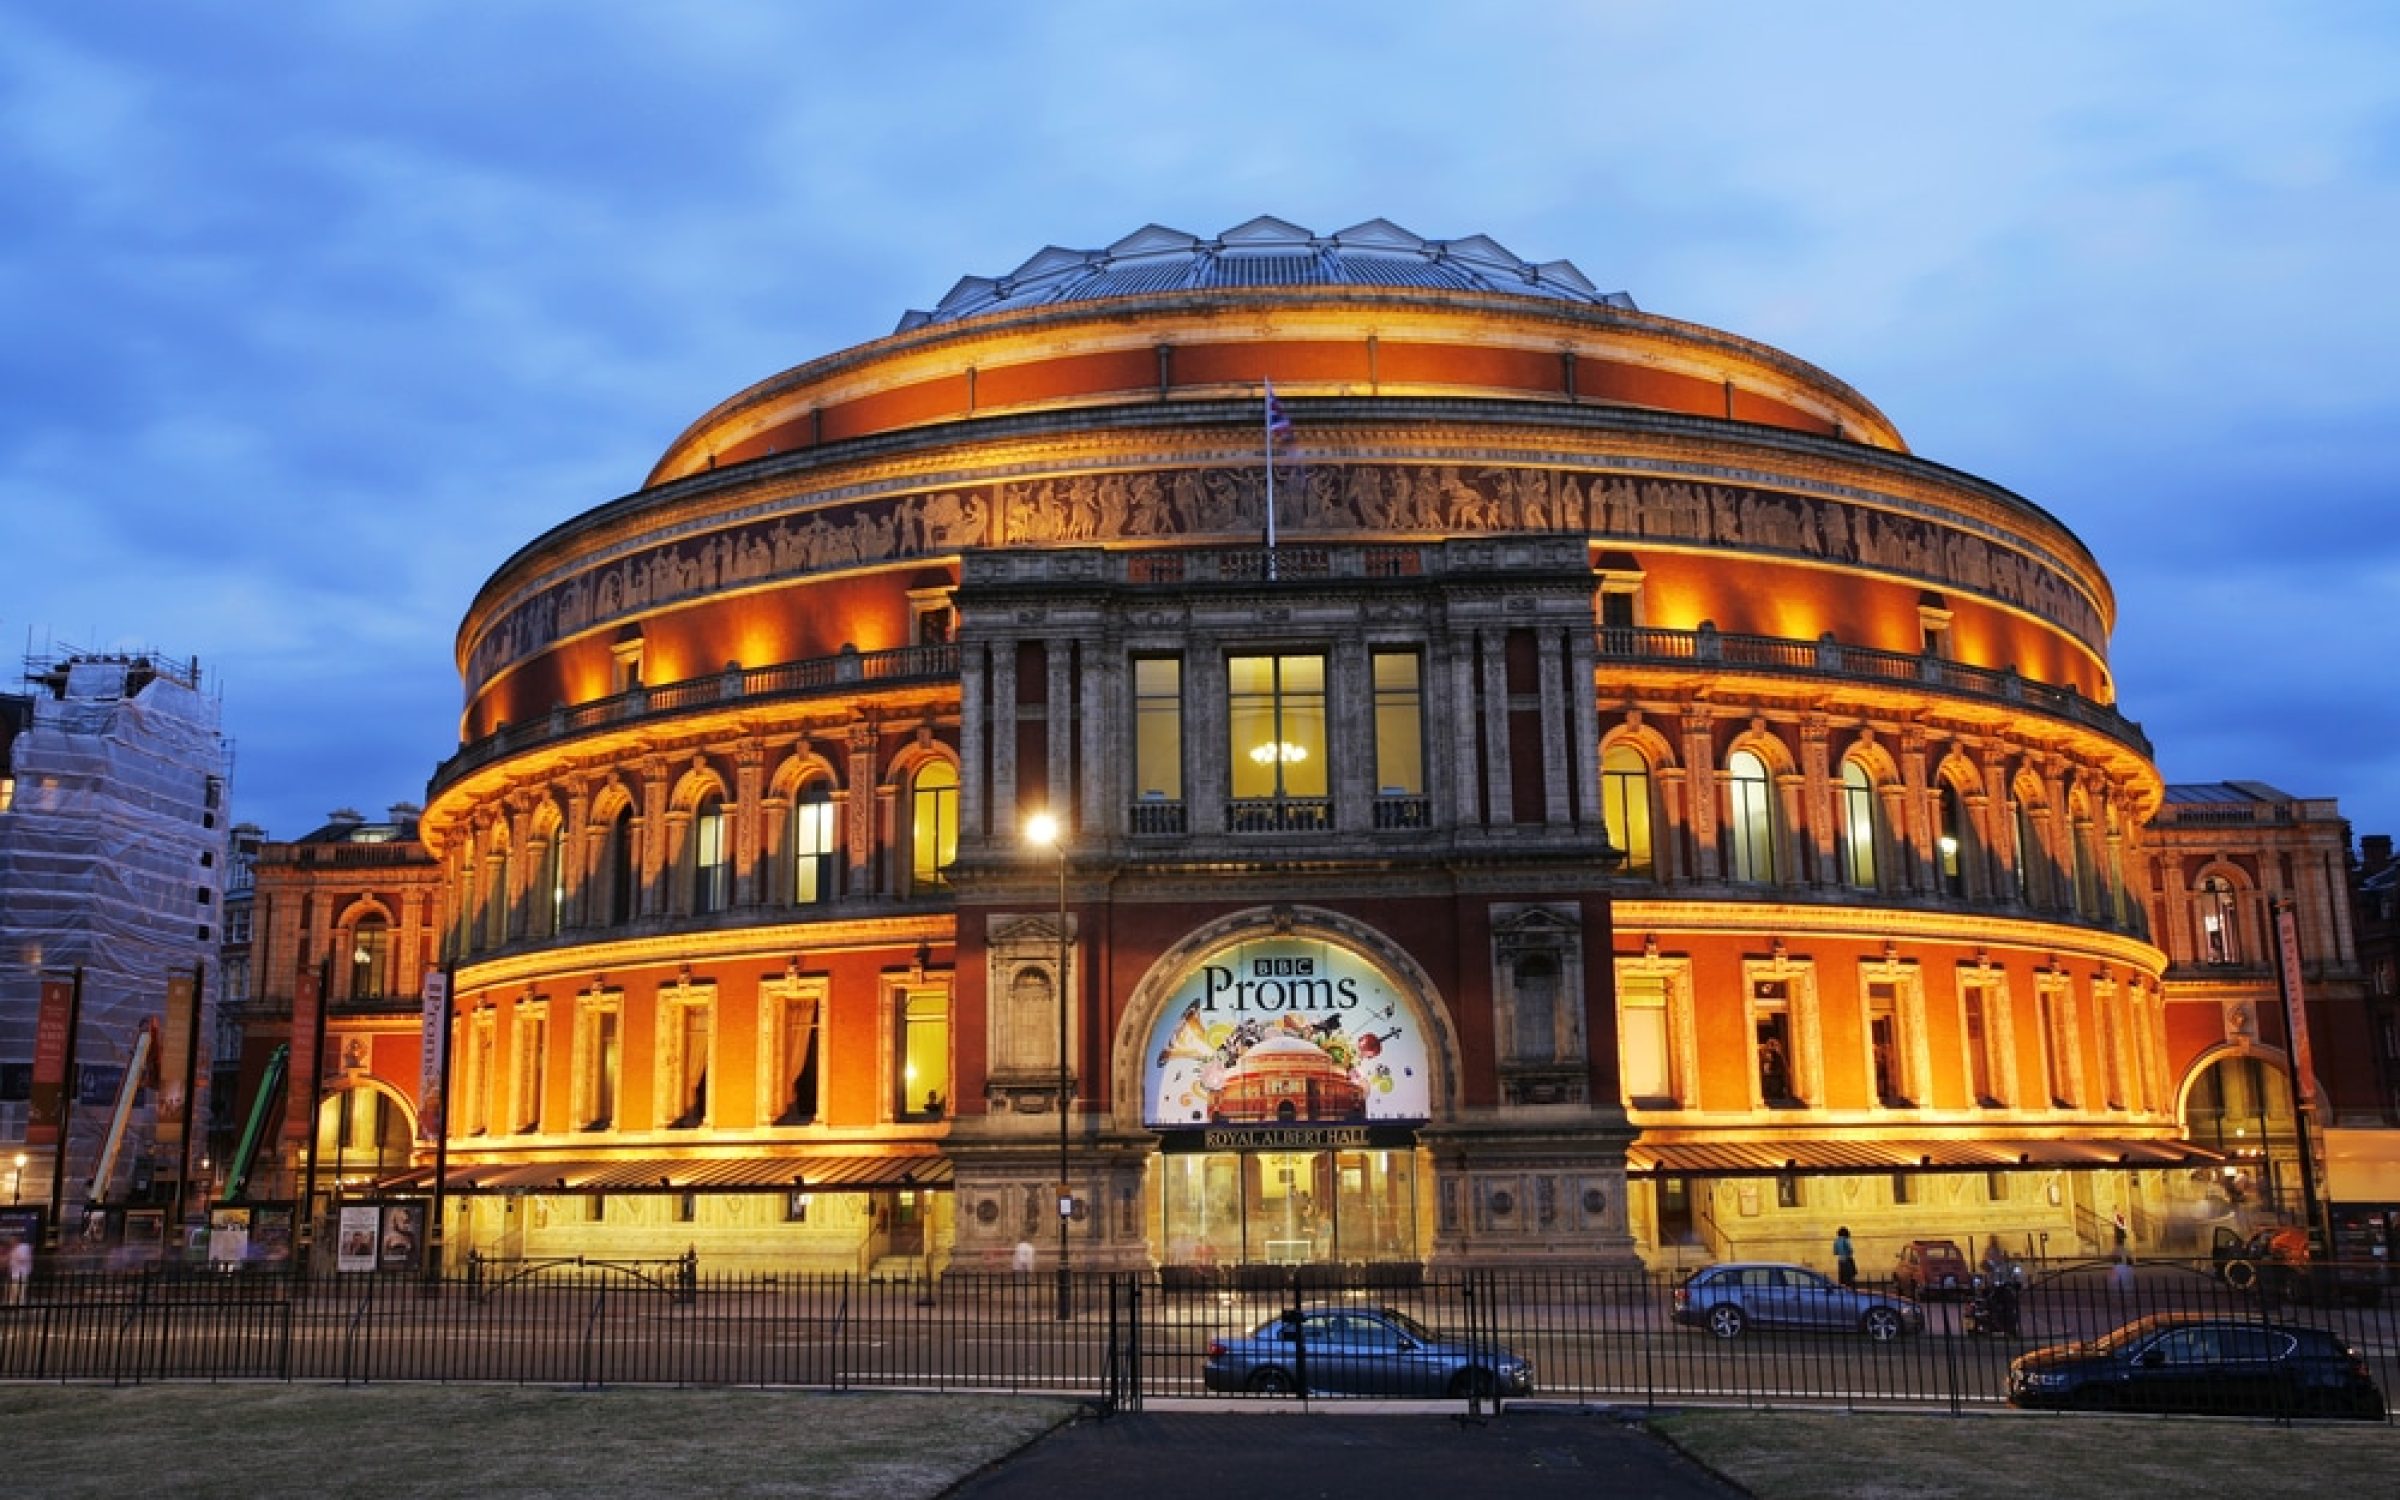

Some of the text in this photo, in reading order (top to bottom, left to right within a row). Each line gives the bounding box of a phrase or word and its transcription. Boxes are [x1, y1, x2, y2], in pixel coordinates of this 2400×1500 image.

[1254, 958, 1314, 977] BBC
[1202, 965, 1359, 1011] Proms
[1207, 1129, 1369, 1146] ROYAL ALBERT HALL
